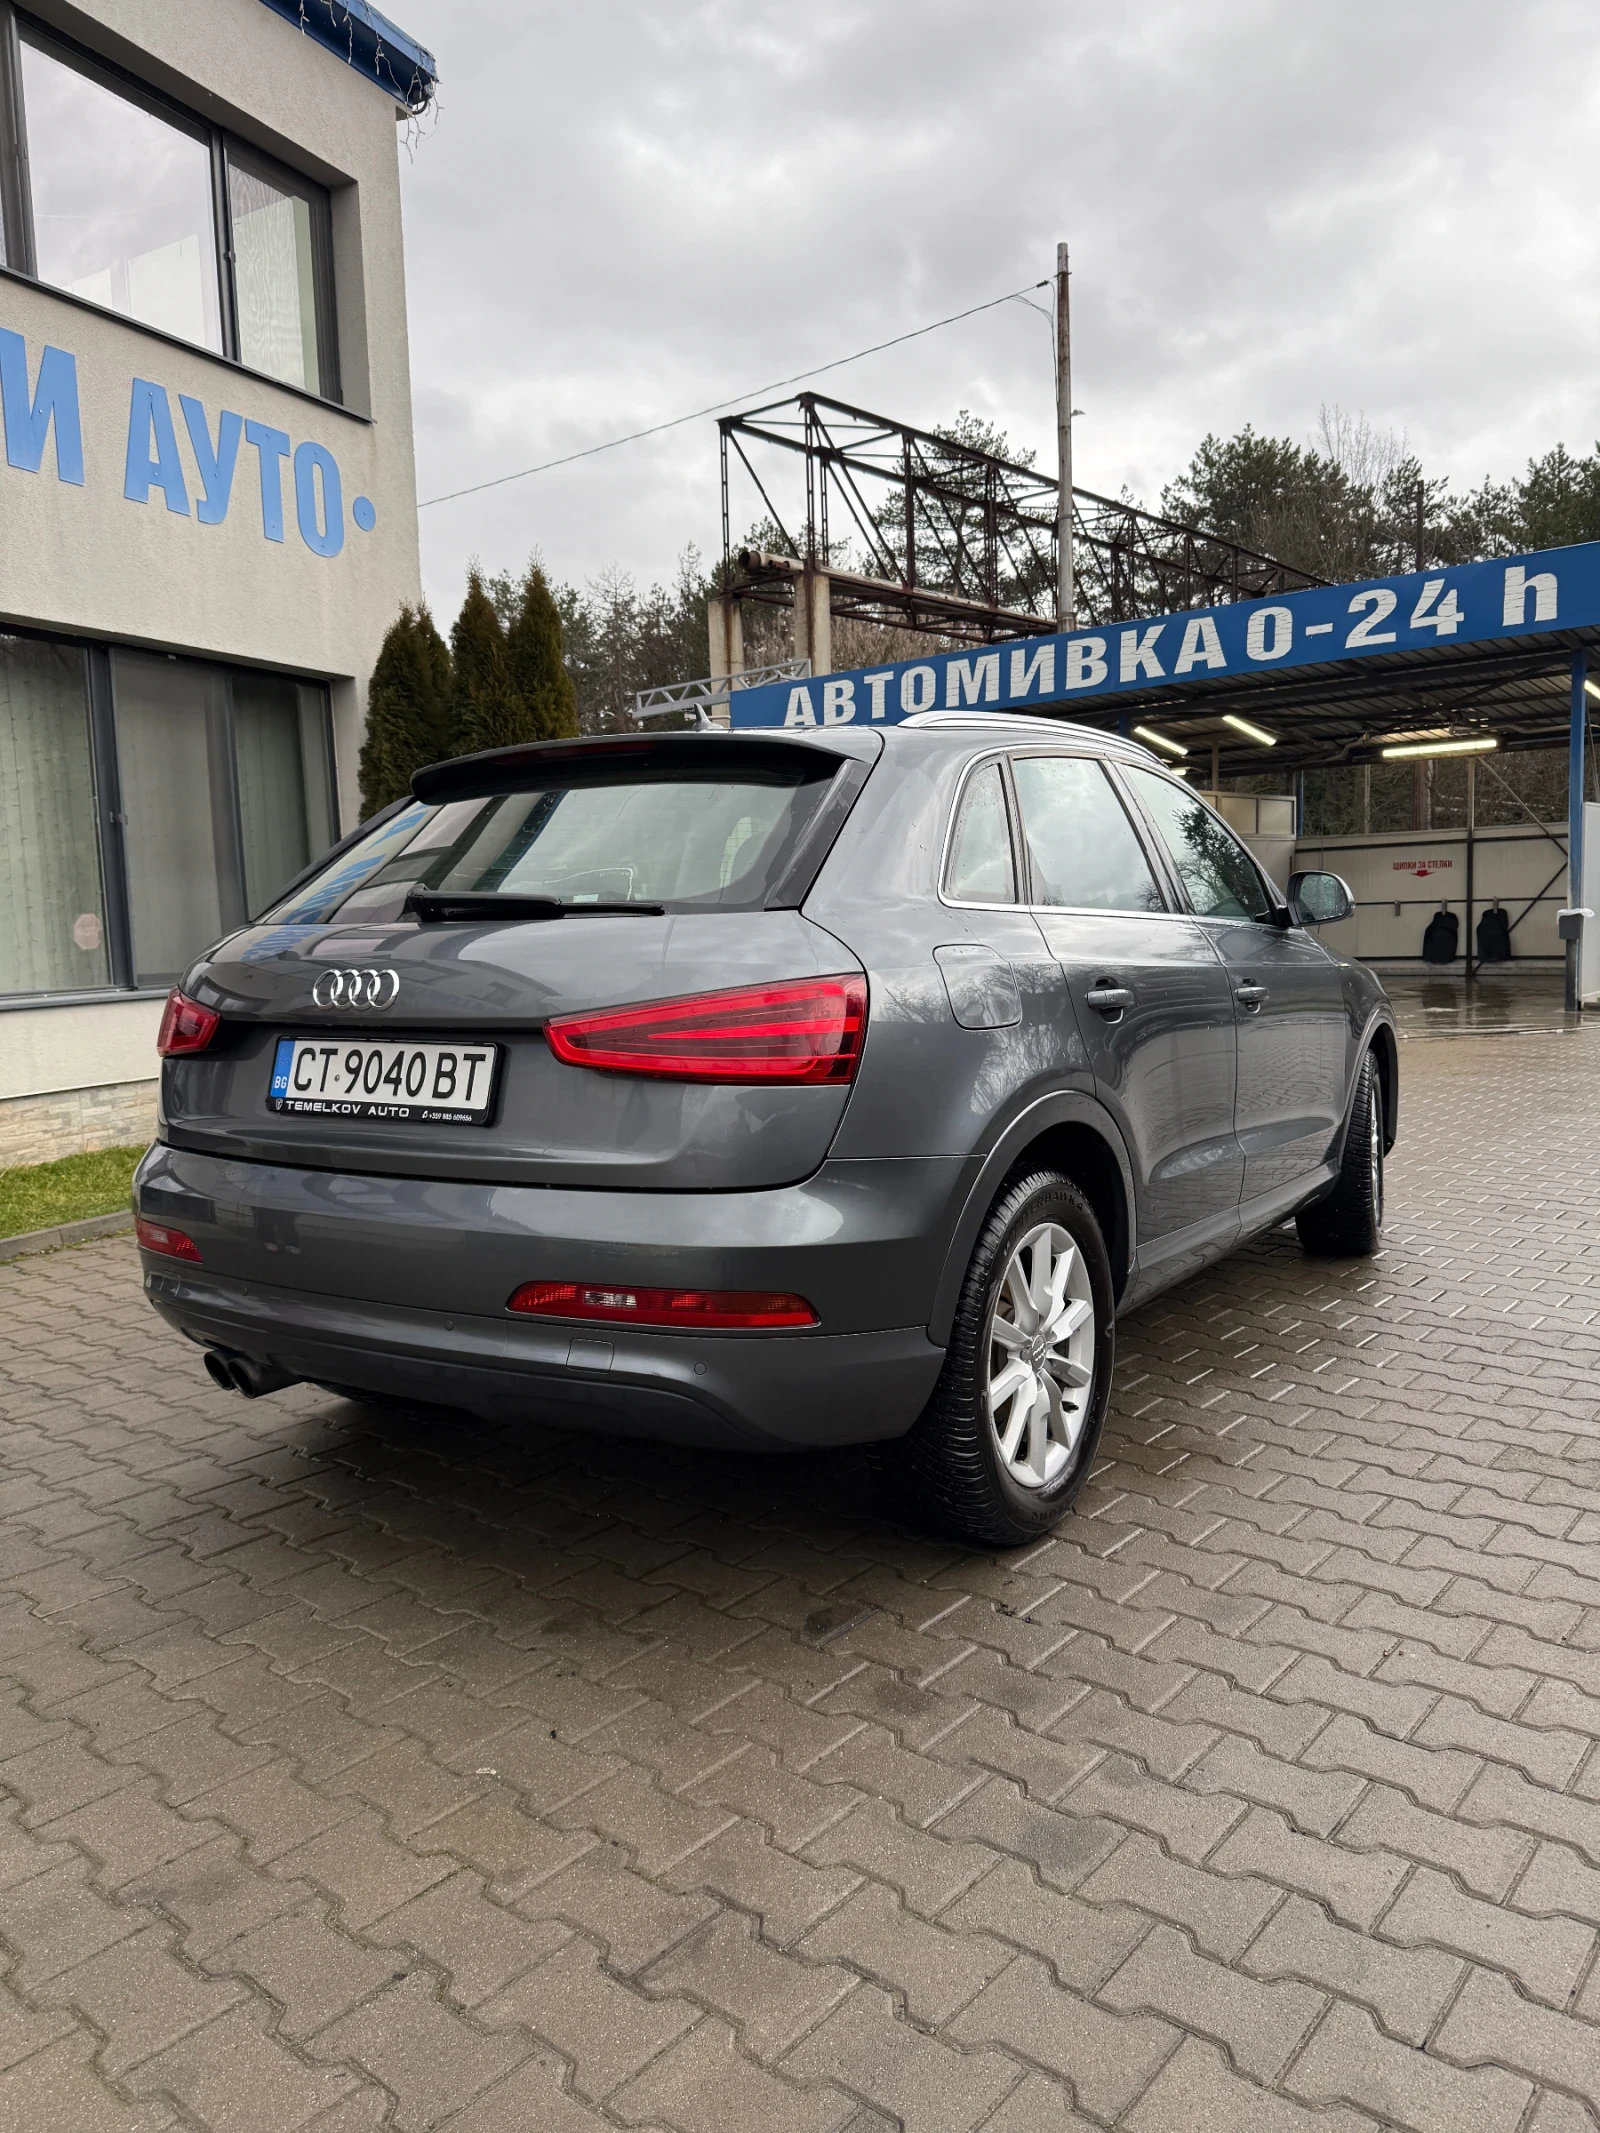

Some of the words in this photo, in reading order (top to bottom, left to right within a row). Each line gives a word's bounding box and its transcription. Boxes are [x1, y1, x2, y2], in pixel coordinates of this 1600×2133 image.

[784, 616, 1227, 726] АВТОМИВКА
[1502, 565, 1558, 627] h
[1418, 861, 1426, 869] ЗА
[1427, 860, 1453, 868] СТЕЛКИ
[274, 1076, 287, 1089] BG
[293, 1047, 338, 1092] CT
[344, 1049, 426, 1097] 9040
[432, 1052, 487, 1101] BT
[286, 1100, 361, 1116] TEMELKOV
[367, 1105, 410, 1117] AUTO
